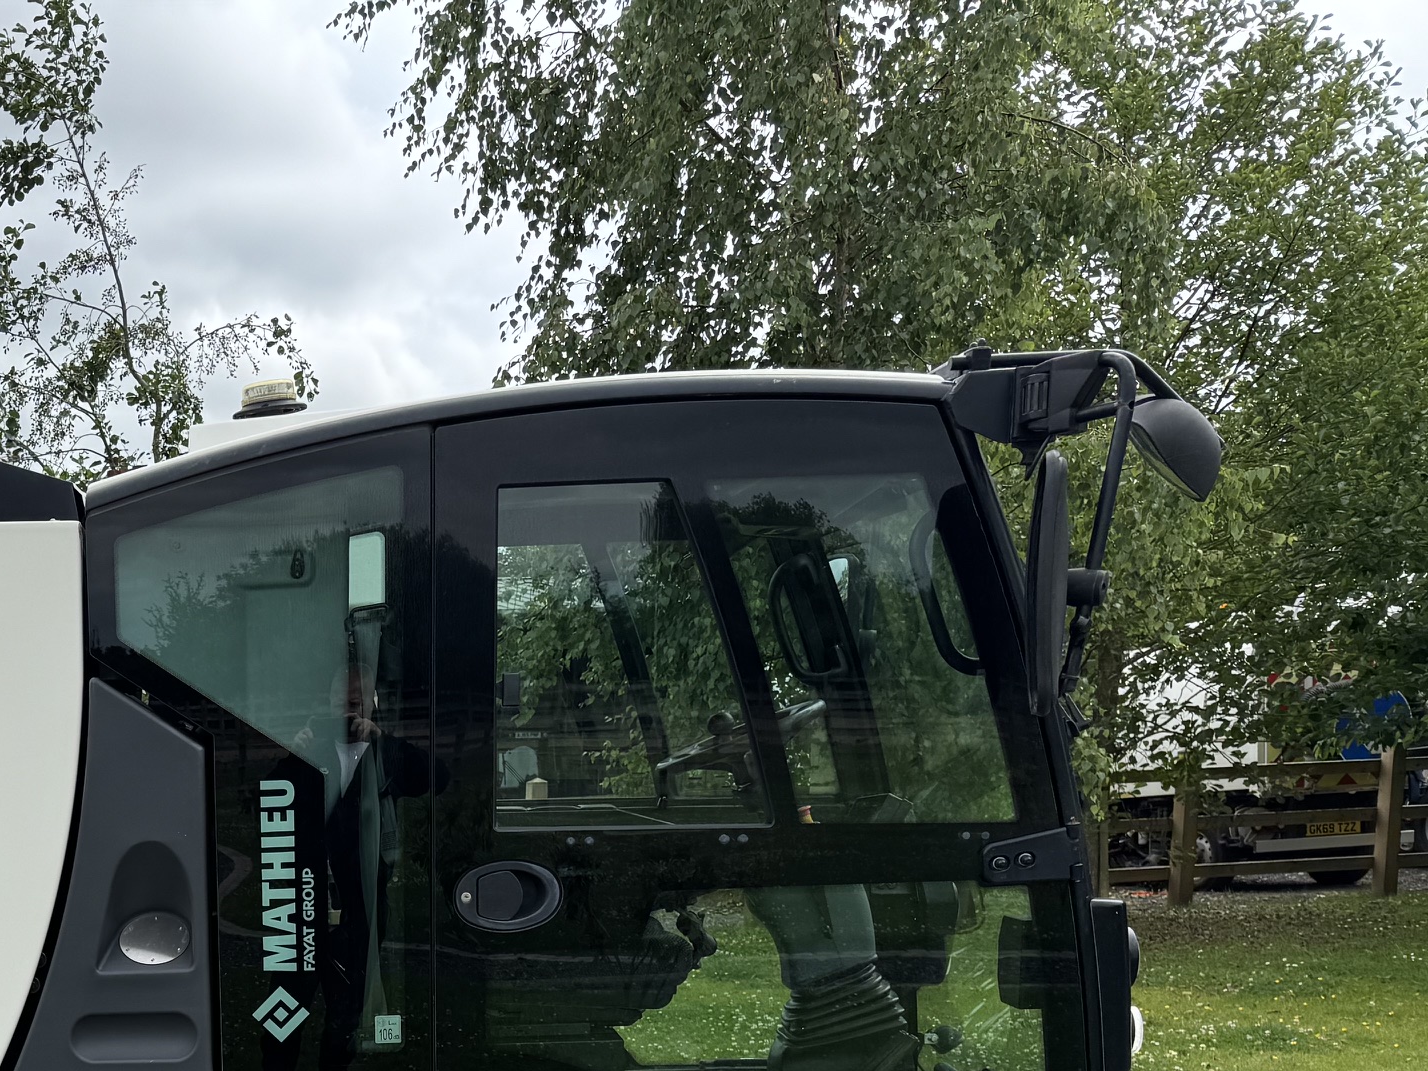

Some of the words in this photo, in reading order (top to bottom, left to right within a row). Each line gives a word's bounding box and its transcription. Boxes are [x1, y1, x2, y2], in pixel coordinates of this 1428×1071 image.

[1309, 823, 1335, 834] GK69
[1337, 821, 1357, 832] TZZ
[259, 779, 297, 972] MATHIEU
[301, 867, 316, 922] GROUP
[303, 926, 316, 972] FAYAT
[379, 1028, 393, 1040] 106
